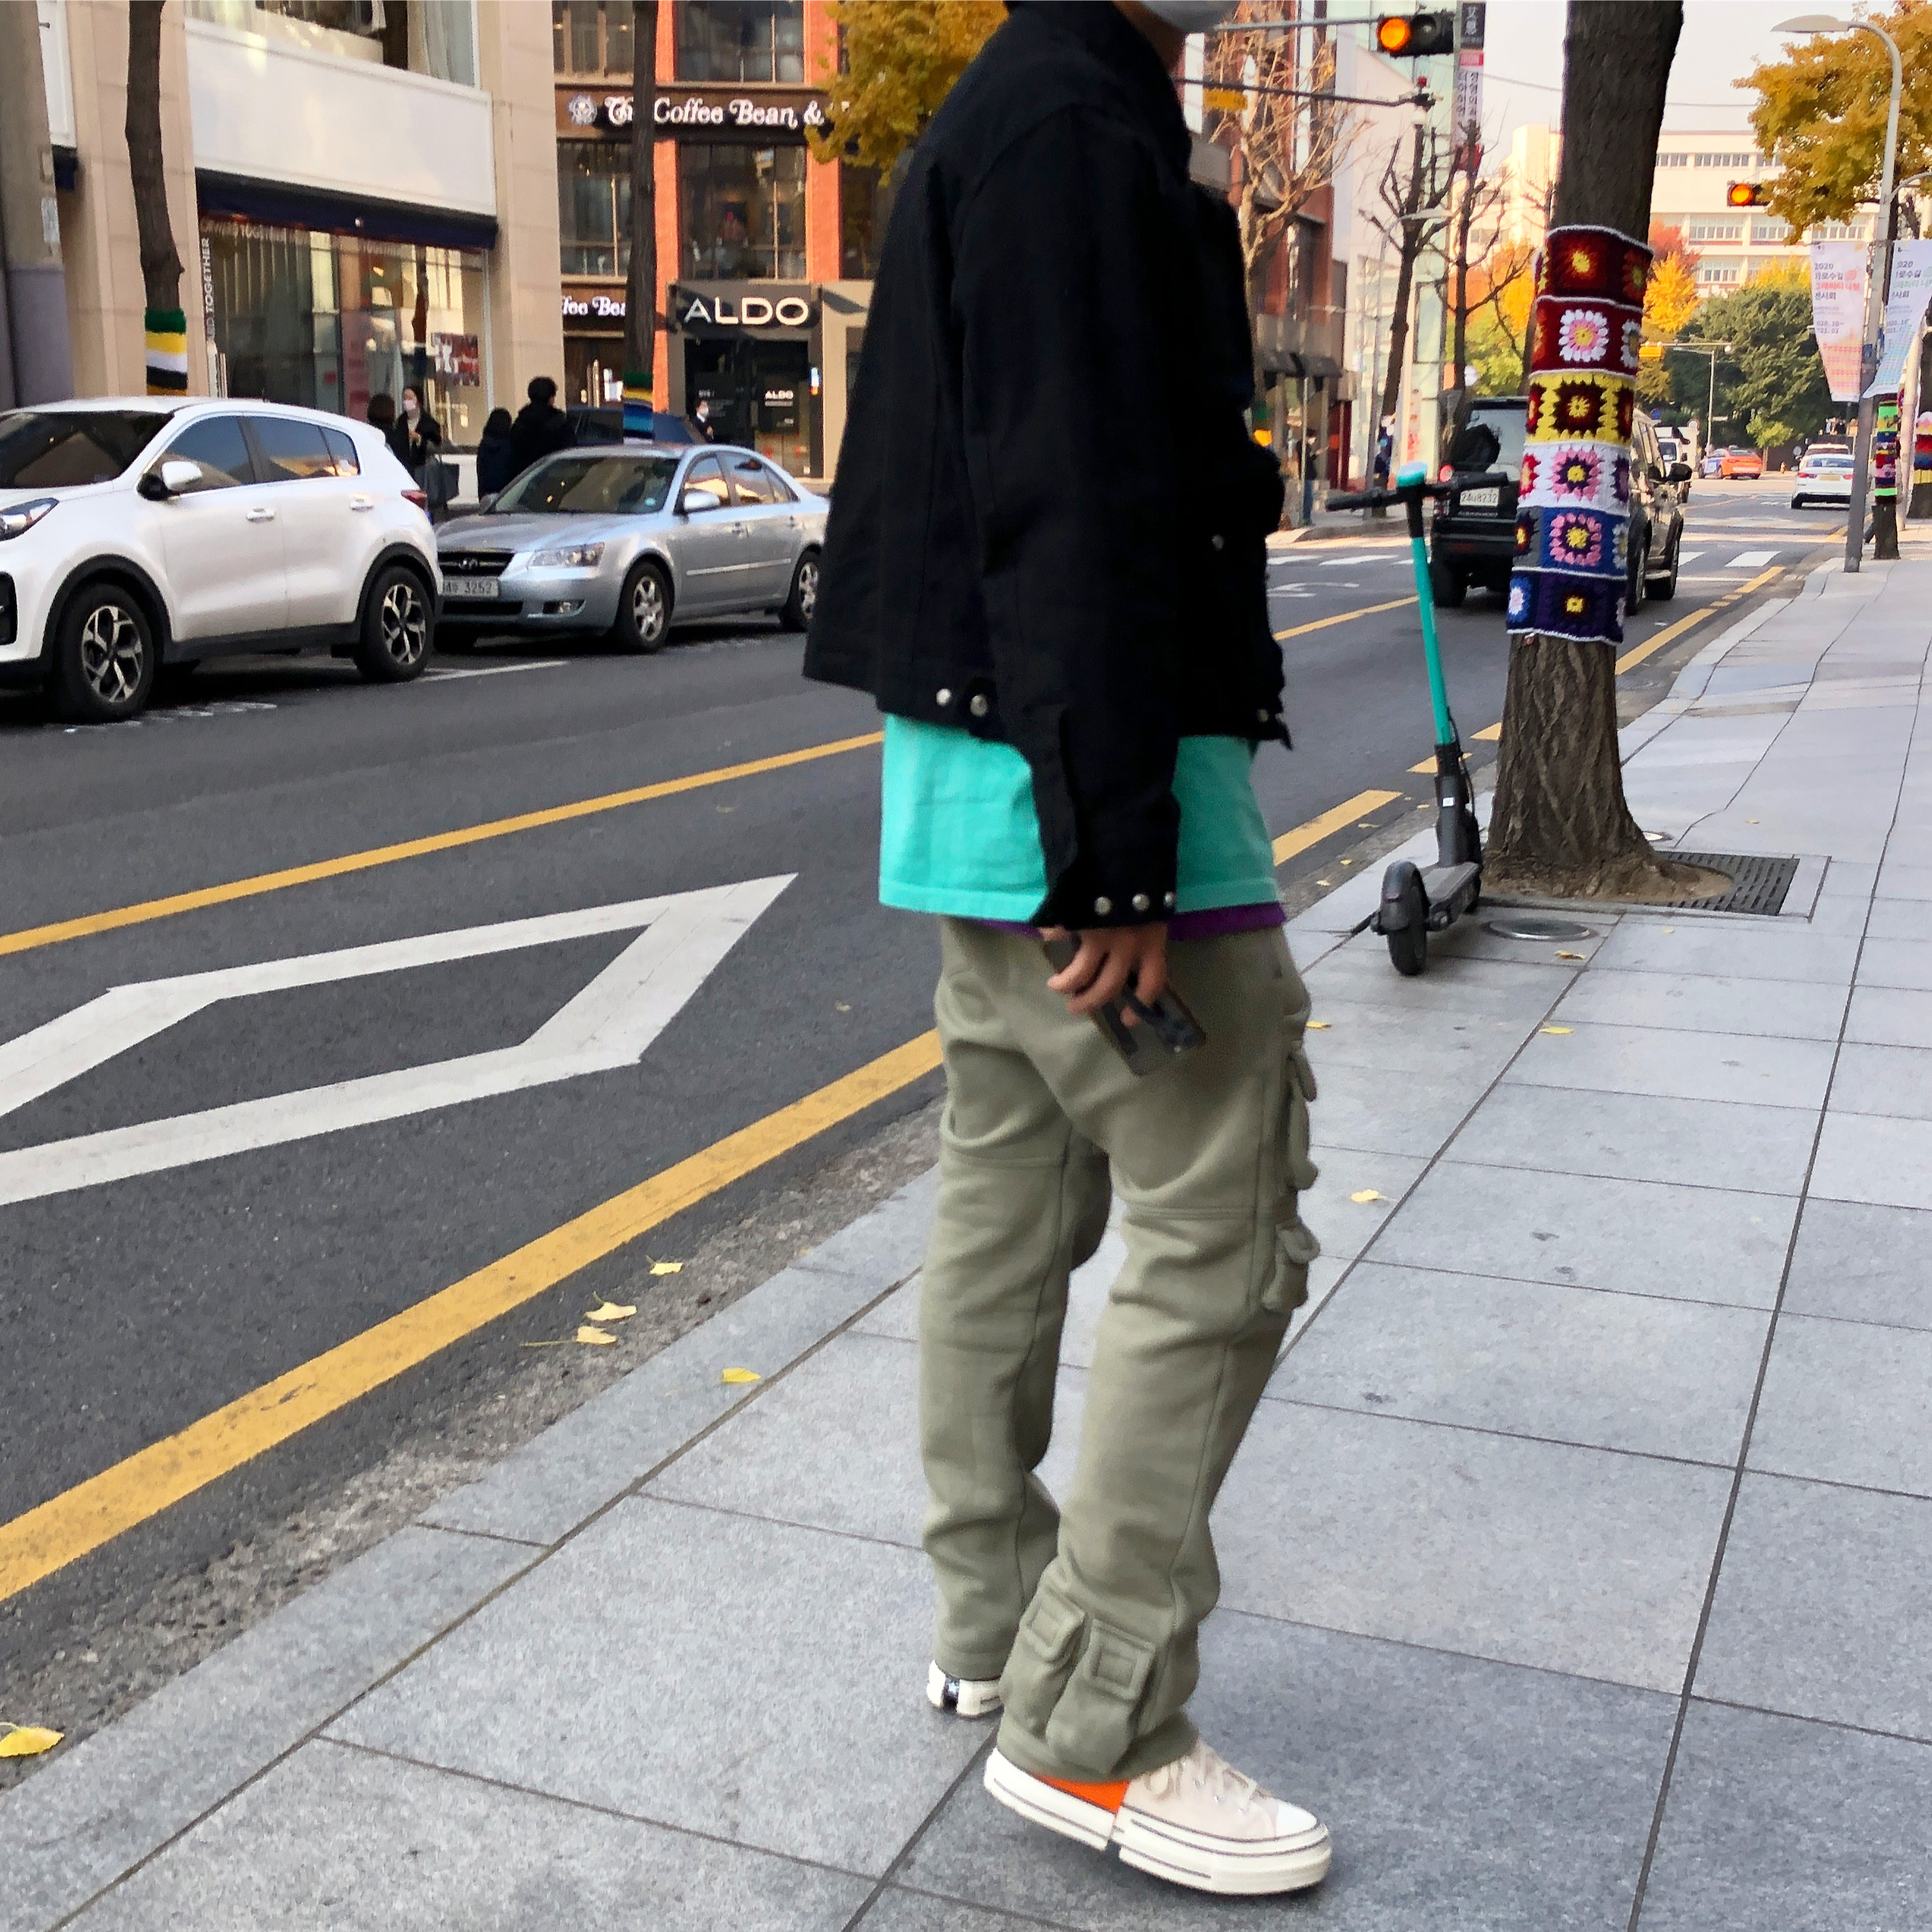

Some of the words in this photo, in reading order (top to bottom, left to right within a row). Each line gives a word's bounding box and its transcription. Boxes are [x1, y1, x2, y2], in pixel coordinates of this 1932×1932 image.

[604, 96, 634, 125] Th
[654, 97, 724, 125] Coffee
[730, 98, 798, 130] Bean
[804, 100, 825, 125] &
[201, 237, 215, 313] TOGETHER
[683, 296, 809, 326] ALDO
[765, 389, 794, 399] ALDO
